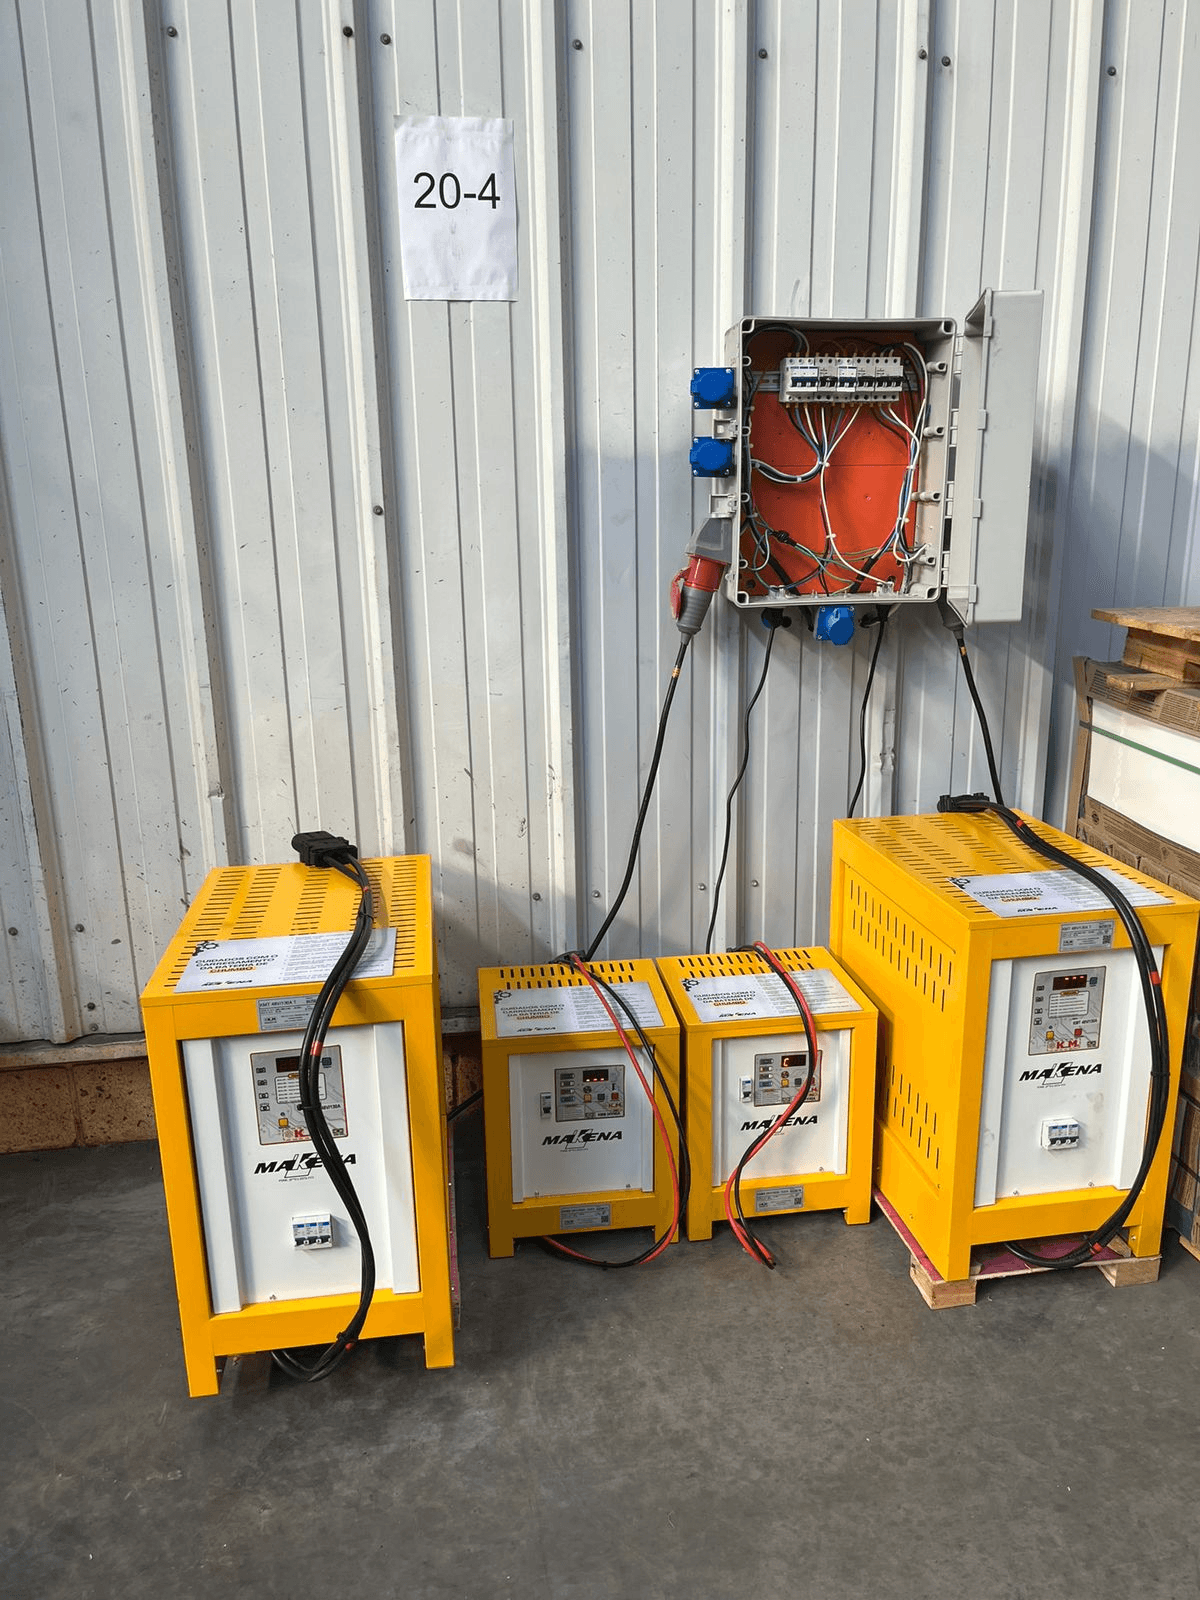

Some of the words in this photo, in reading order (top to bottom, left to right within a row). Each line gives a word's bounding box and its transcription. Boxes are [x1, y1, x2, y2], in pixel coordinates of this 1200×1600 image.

[414, 172, 500, 209] 20-4
[1019, 1062, 1102, 1084] MAKENA
[542, 1129, 622, 1148] MAKENA
[254, 1152, 356, 1177] MAKEA
